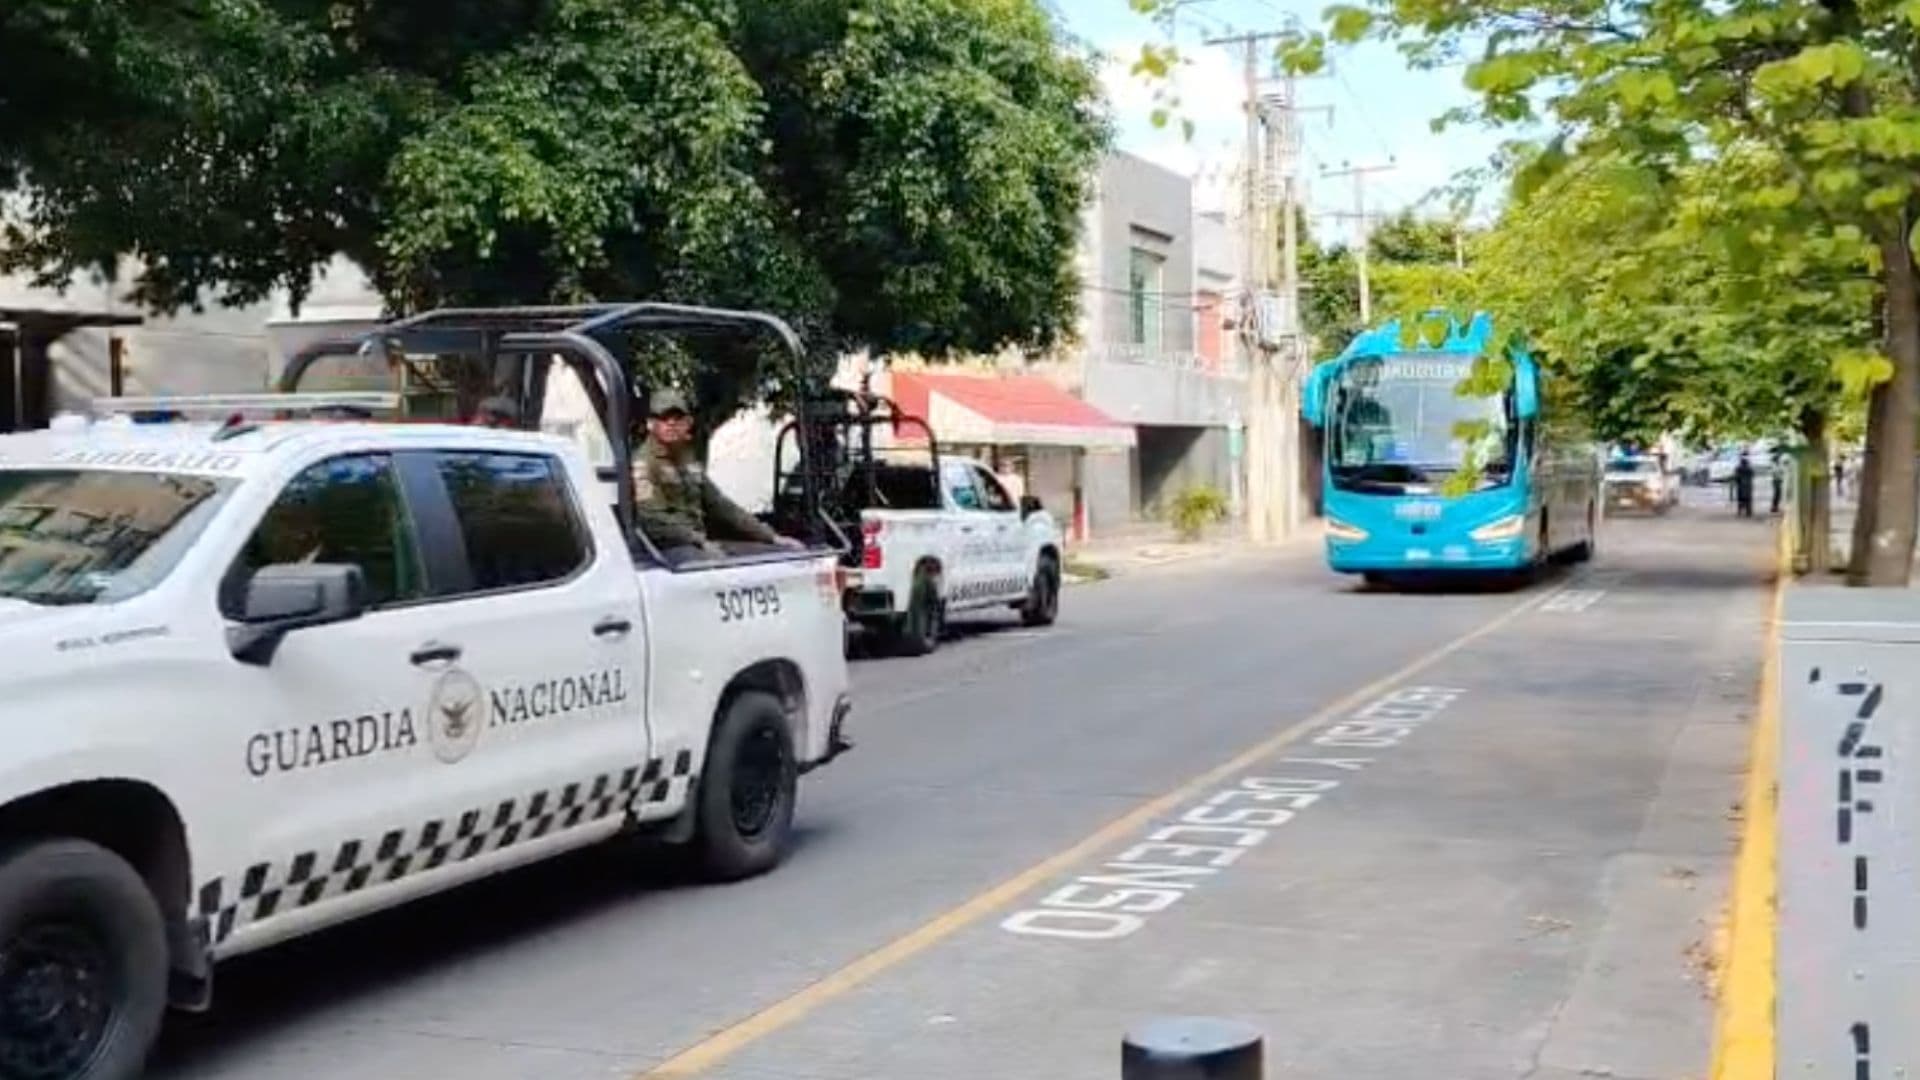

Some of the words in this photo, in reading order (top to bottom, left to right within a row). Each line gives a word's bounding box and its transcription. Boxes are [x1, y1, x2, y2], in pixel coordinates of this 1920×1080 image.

[715, 584, 781, 622] 30799
[246, 708, 417, 777] GUARDIA
[489, 668, 627, 728] NACIONAL
[1278, 757, 1376, 771] Y
[1000, 777, 1340, 940] DESCENSO
